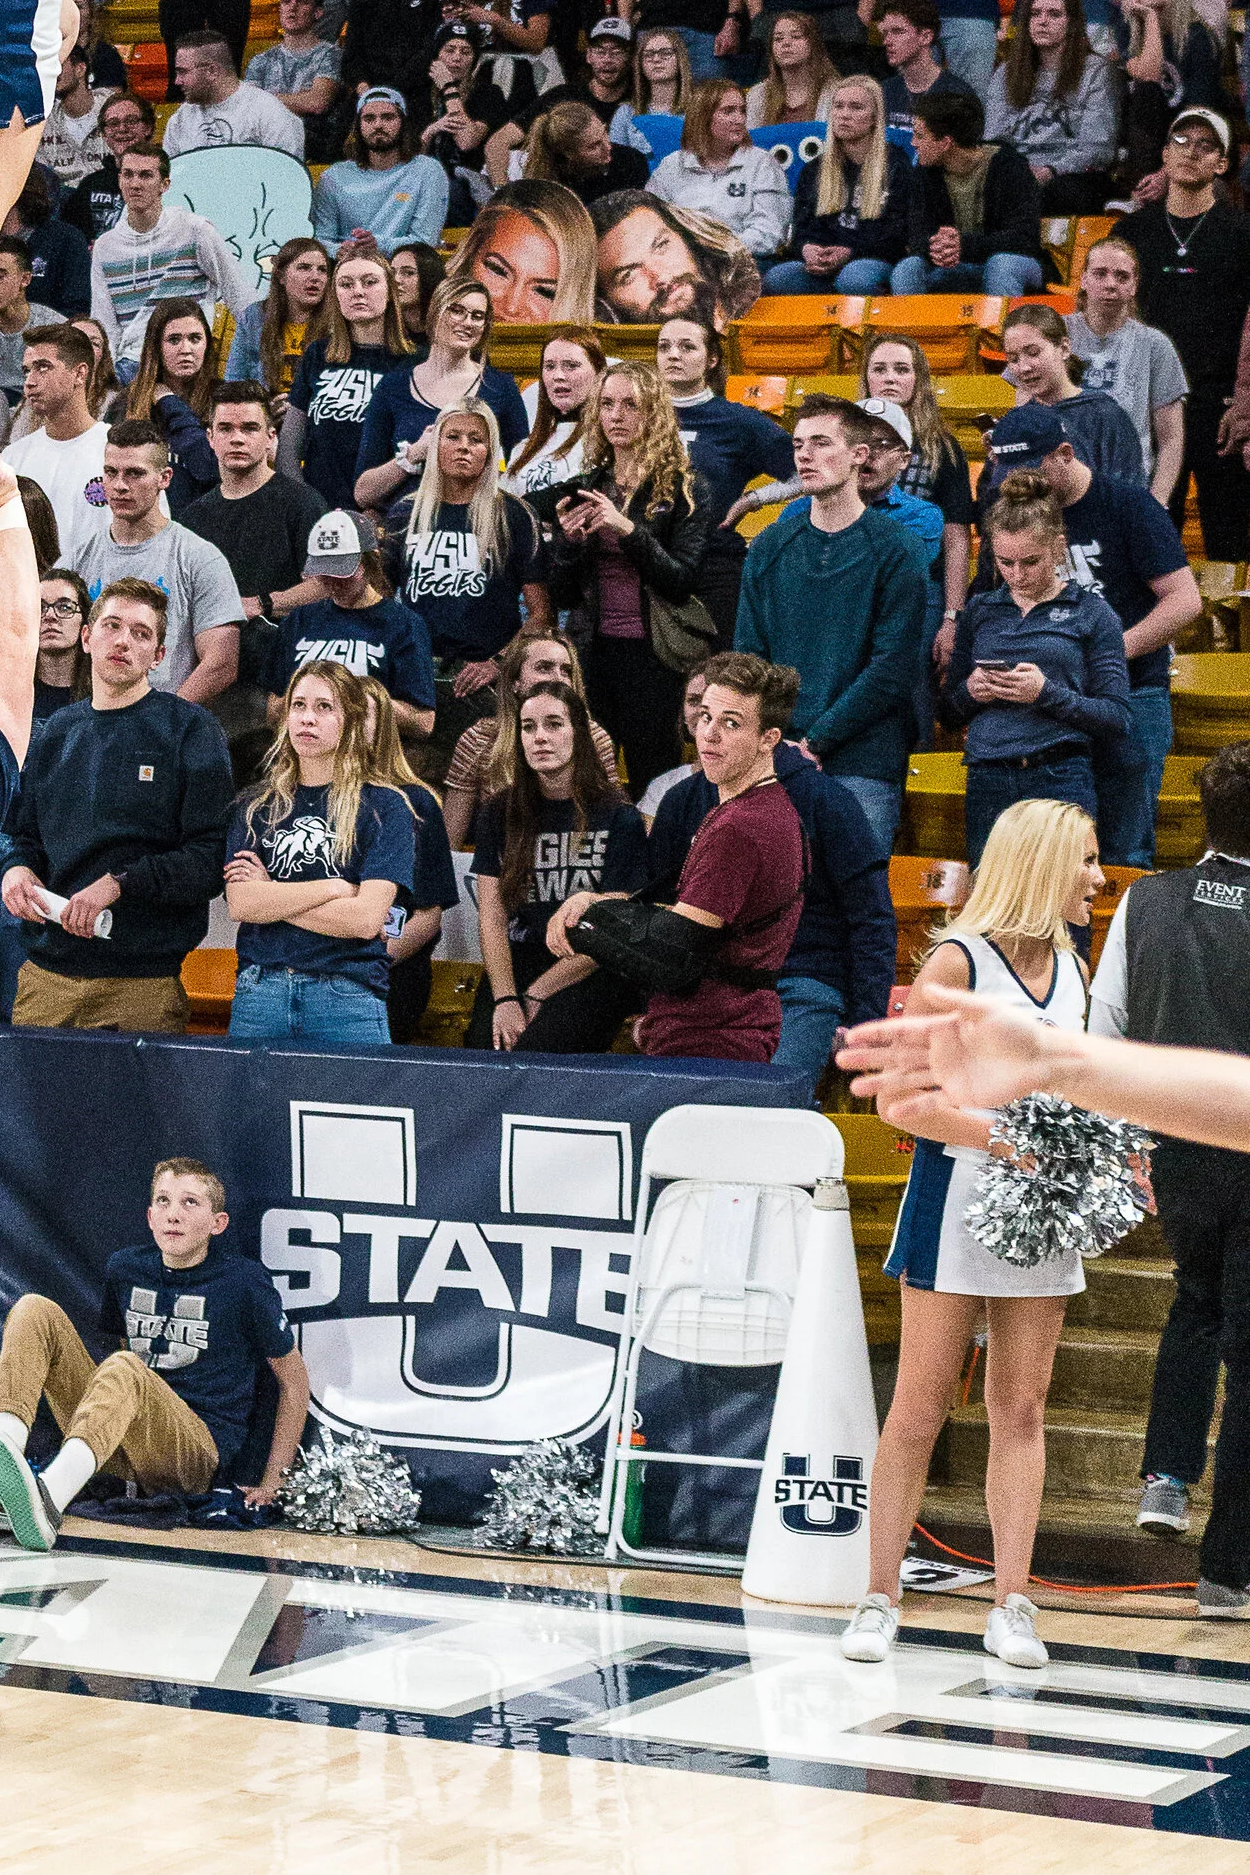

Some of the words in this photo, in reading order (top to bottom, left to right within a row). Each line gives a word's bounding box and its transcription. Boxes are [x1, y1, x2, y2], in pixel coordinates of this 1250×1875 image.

[404, 530, 481, 572] USU
[405, 566, 488, 604] AGGIES
[1197, 878, 1247, 898] EVENT
[260, 1206, 635, 1339] STATE
[125, 1309, 210, 1350] STATE
[774, 1478, 868, 1511] STATE
